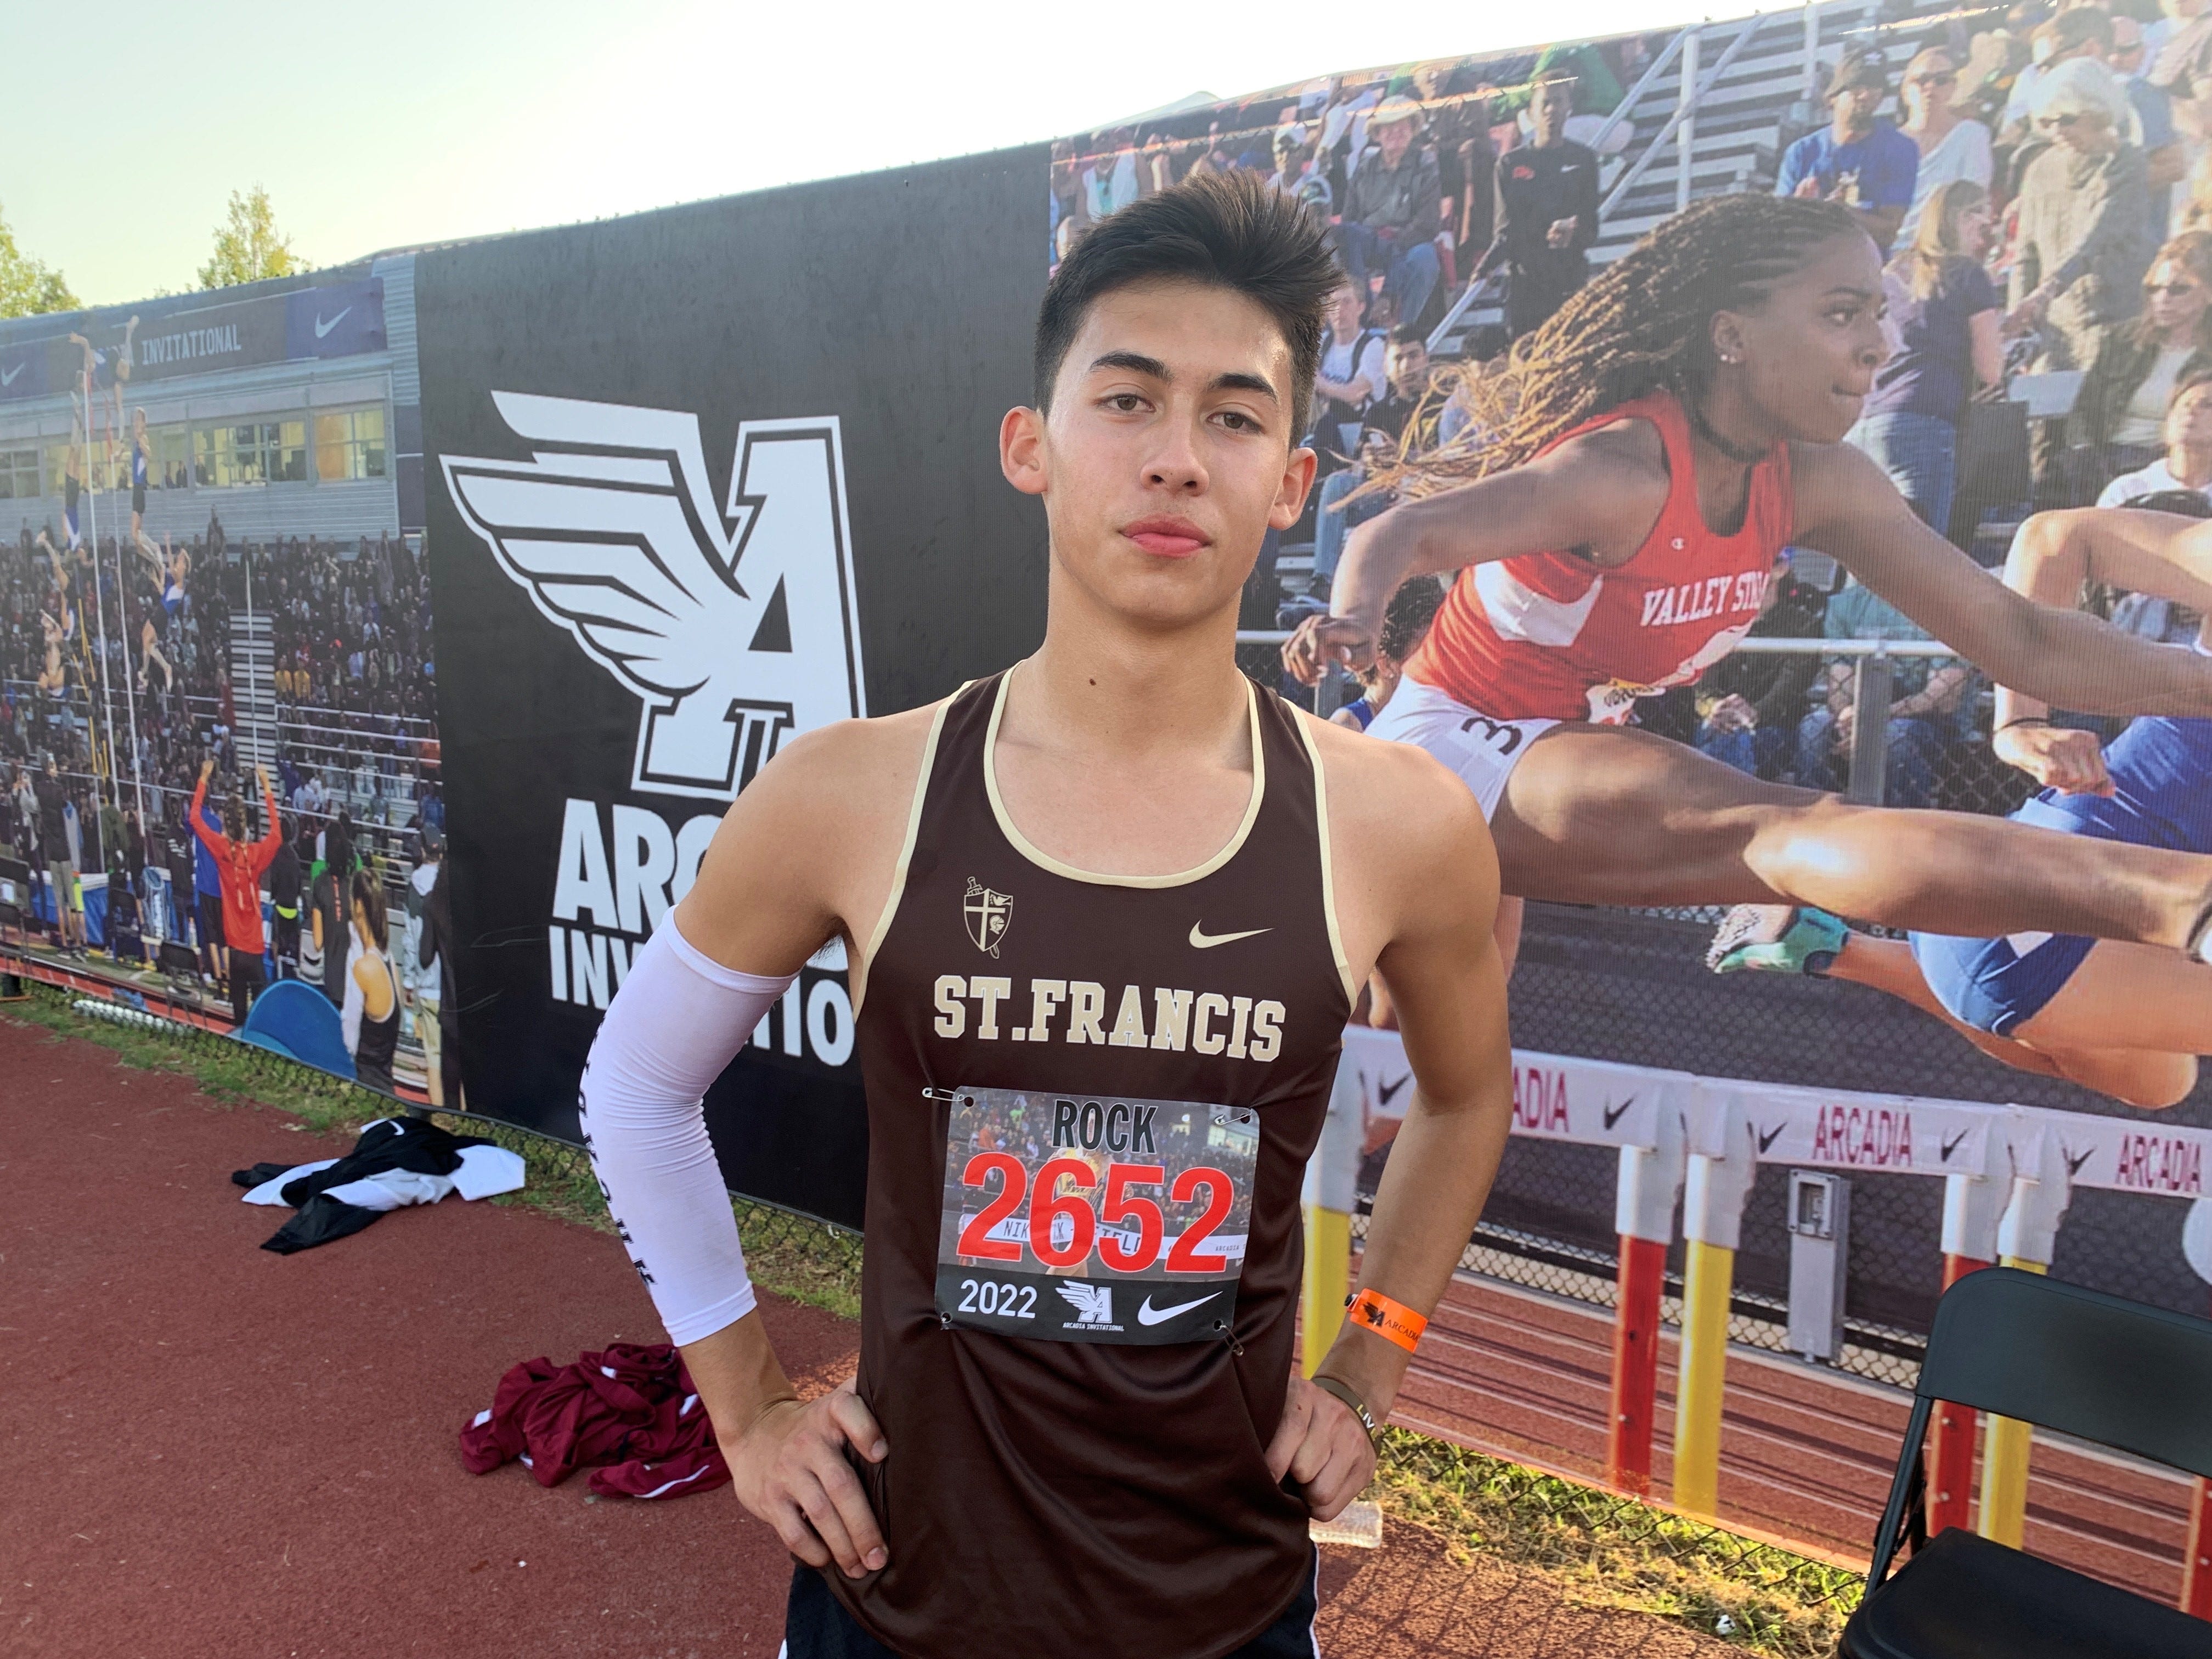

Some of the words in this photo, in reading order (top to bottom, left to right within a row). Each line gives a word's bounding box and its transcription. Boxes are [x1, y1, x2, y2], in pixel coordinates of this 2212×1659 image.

[142, 324, 241, 366] INVITATIONAL
[1640, 575, 1733, 627] VALLEY
[1514, 1067, 1570, 1132] ADIA
[1052, 1099, 1159, 1154] ROCK
[1812, 1105, 1912, 1167] ARCADIA
[2115, 1133, 2202, 1193] ARCADIA
[956, 1152, 1234, 1273] 2652
[1003, 1221, 1030, 1239] NIK
[957, 1279, 1037, 1319] 2022
[1087, 1323, 1125, 1331] INVITATIONAL
